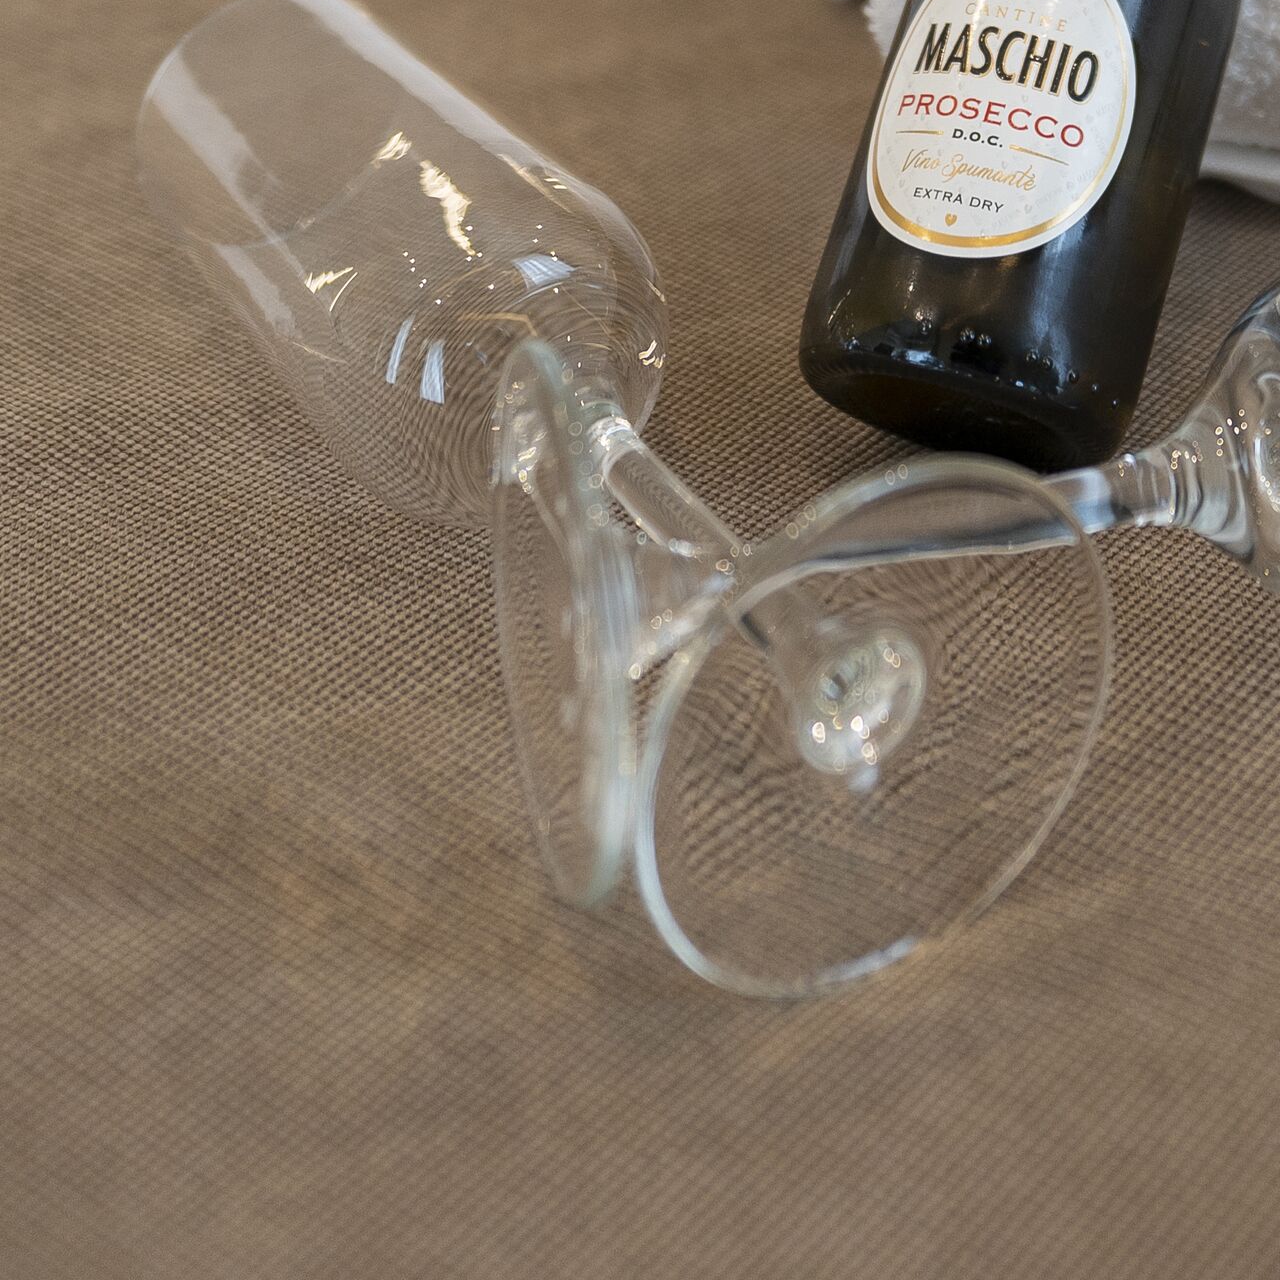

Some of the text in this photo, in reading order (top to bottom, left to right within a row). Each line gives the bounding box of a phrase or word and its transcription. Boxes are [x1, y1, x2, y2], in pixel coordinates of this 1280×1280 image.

[965, 2, 1068, 32] CANTINE
[913, 22, 1101, 104] MASCHIO
[897, 93, 1084, 148] PROSECCO
[952, 127, 1003, 148] D.O.C.
[901, 148, 1037, 192] Vino Spumante
[913, 186, 1004, 214] EXTRA DRY
